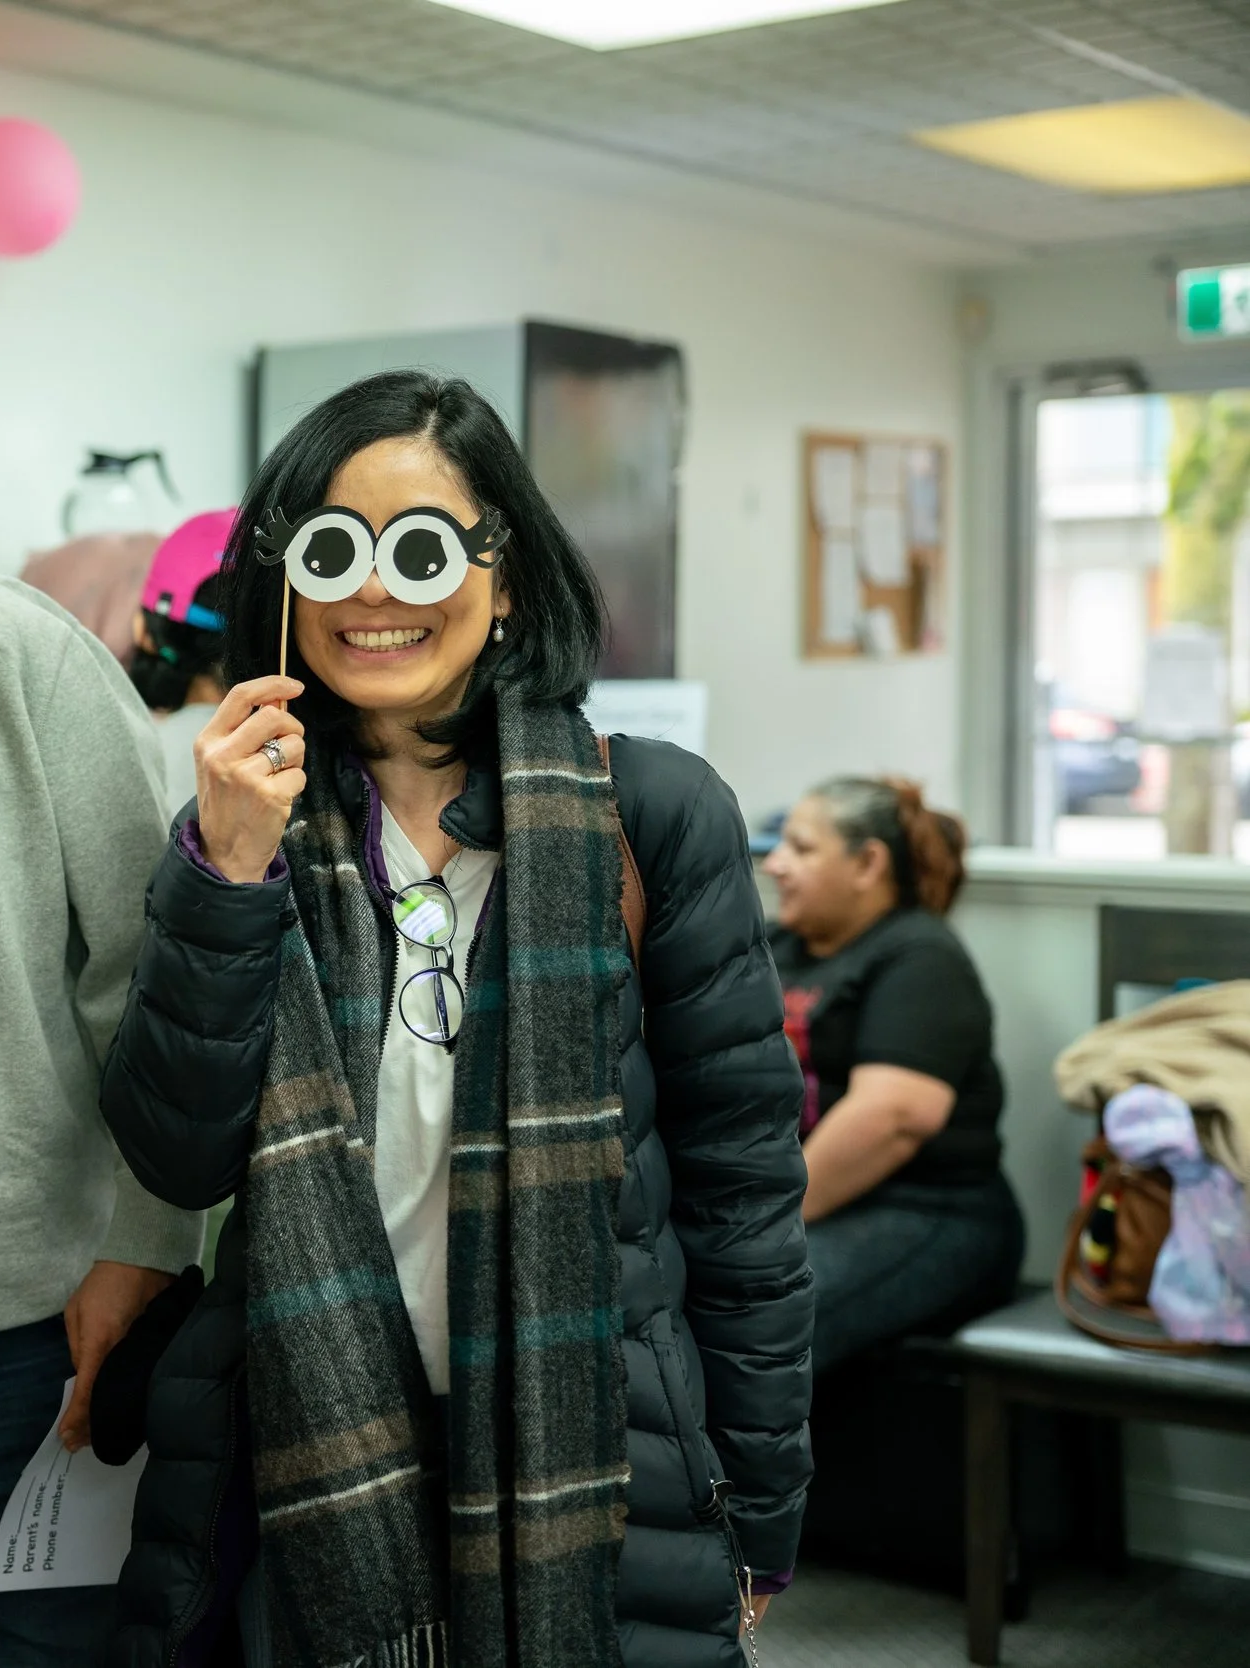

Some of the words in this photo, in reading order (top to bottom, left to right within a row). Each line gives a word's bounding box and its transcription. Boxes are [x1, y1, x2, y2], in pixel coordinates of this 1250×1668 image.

[2, 1534, 18, 1574] Name:
[22, 1521, 39, 1573] Parent's
[33, 1482, 47, 1517] name:
[42, 1530, 57, 1571] Phone
[51, 1473, 66, 1526] number:
